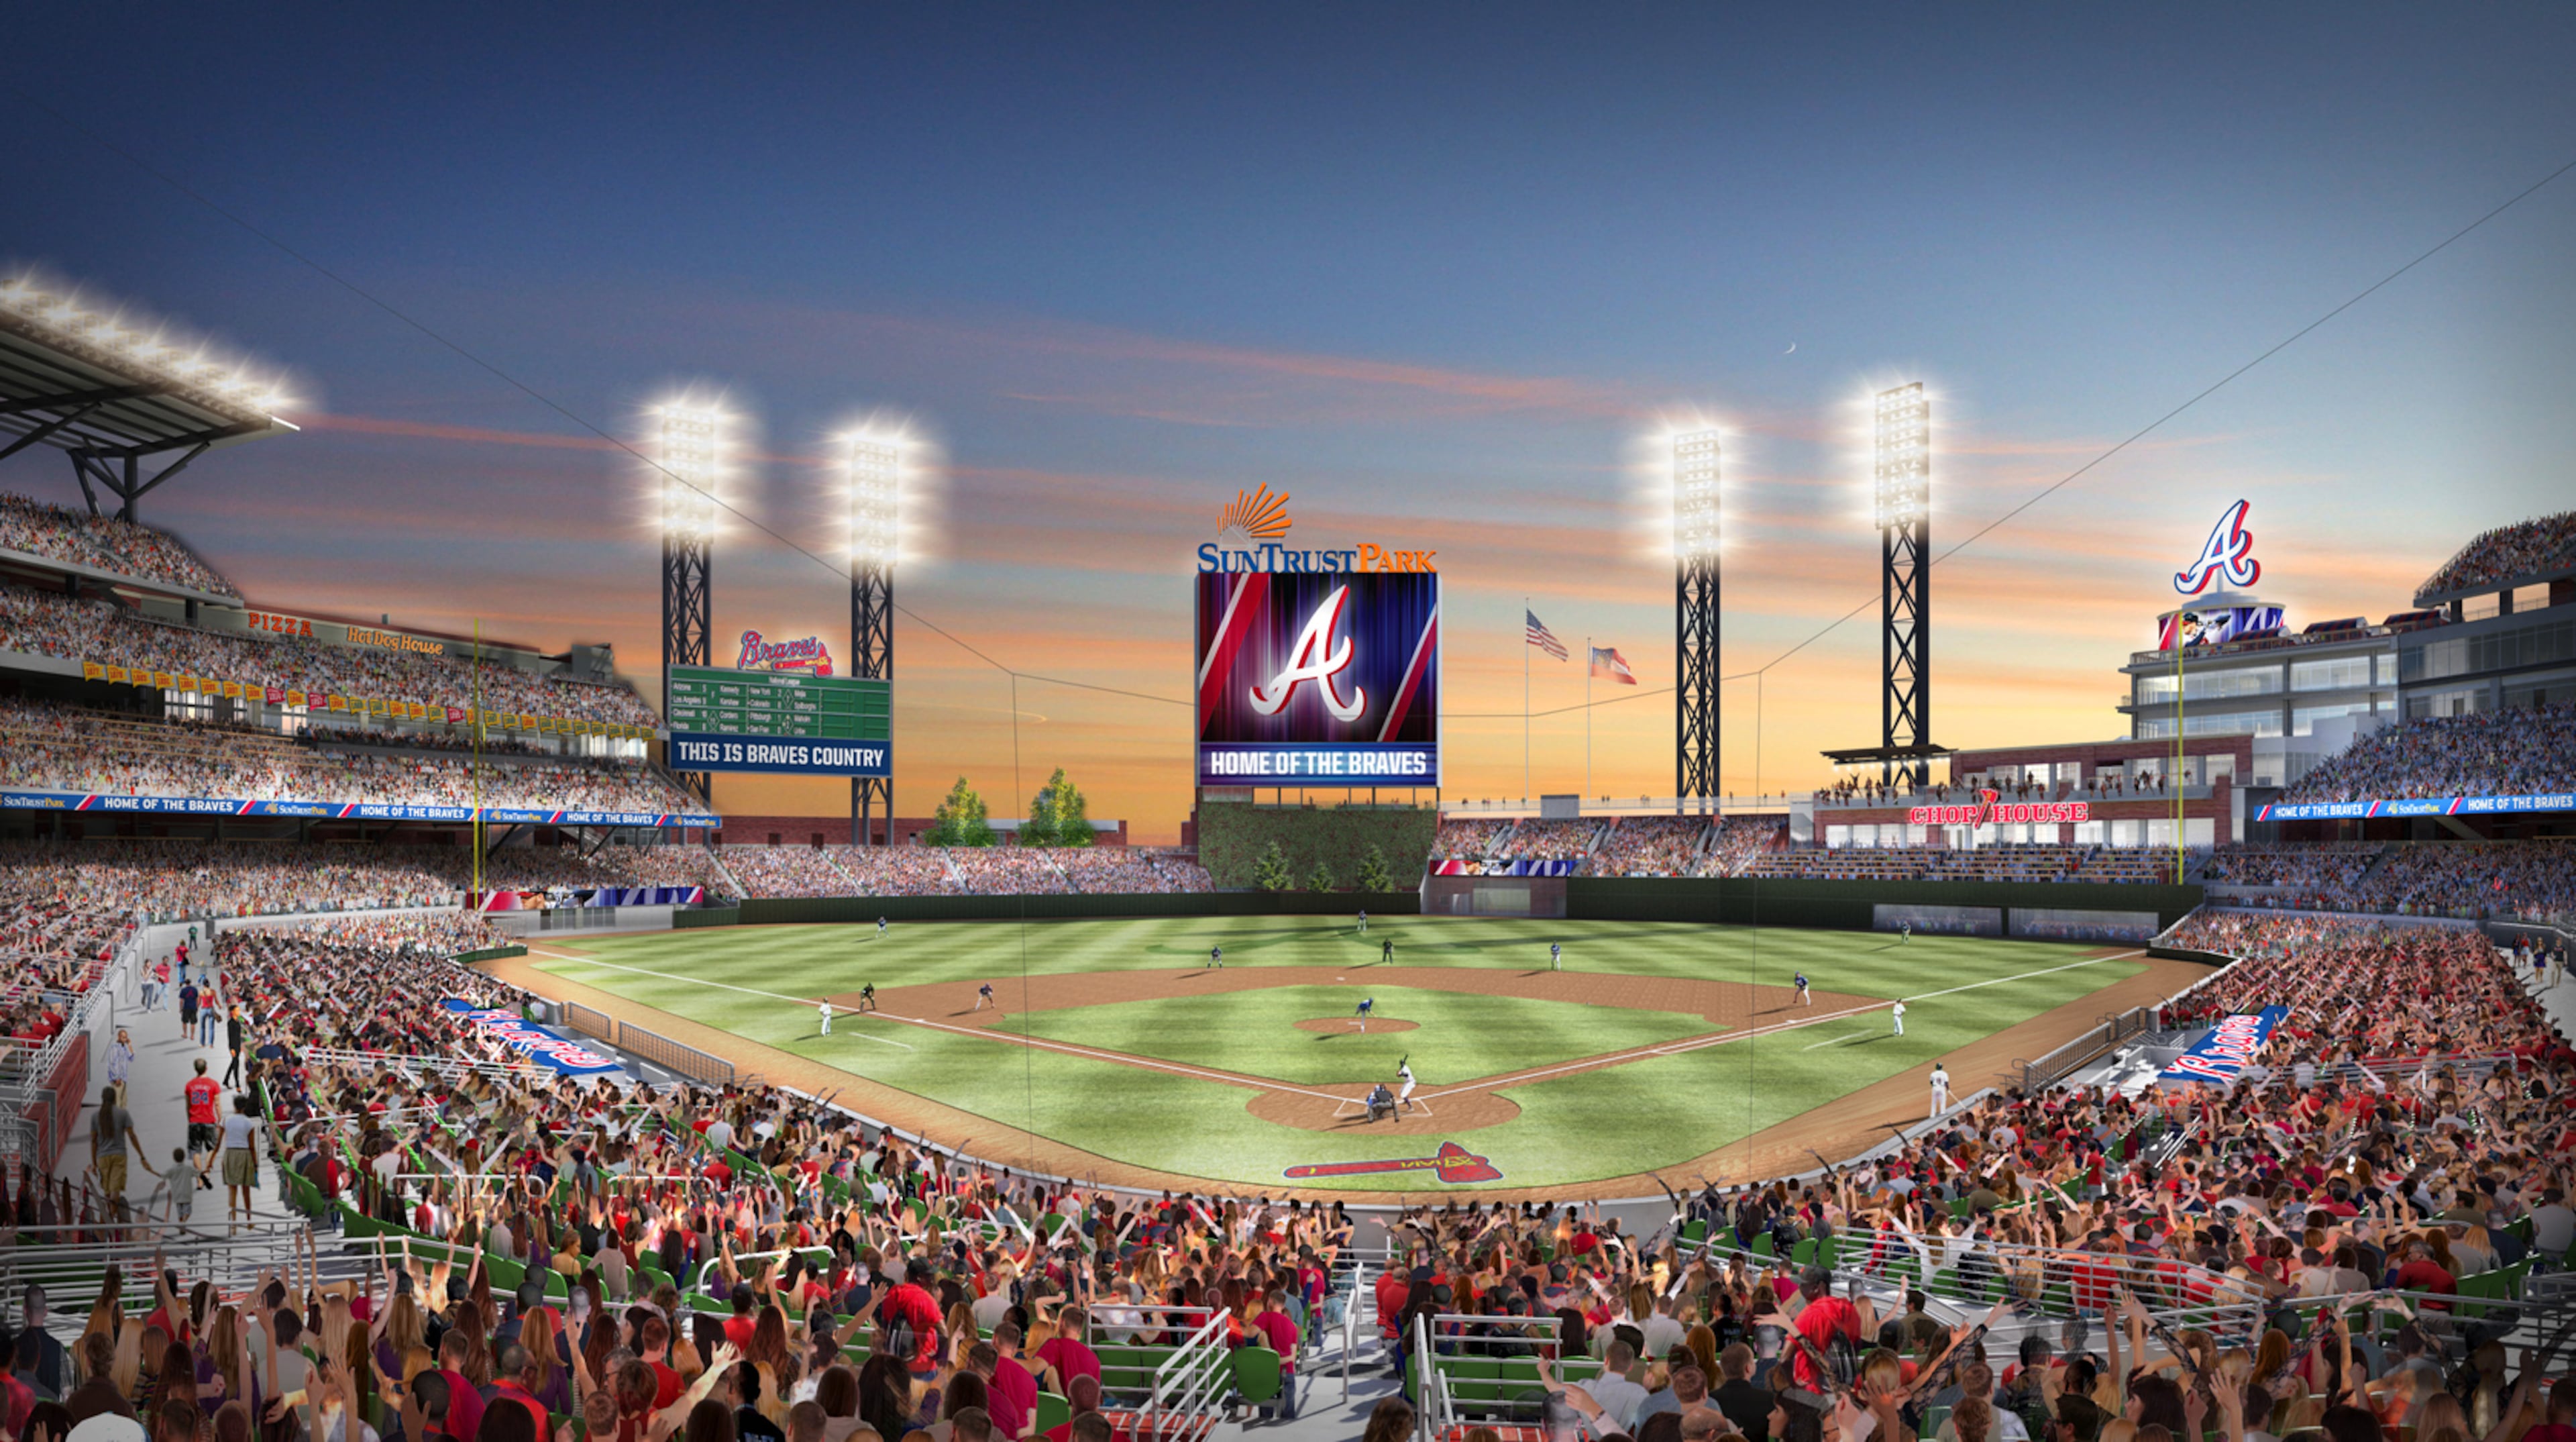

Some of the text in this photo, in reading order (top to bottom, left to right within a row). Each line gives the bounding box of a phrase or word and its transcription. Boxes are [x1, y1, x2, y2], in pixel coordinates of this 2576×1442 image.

[2174, 499, 2260, 595] A
[248, 612, 313, 637] PIZZA
[347, 627, 443, 656] Hot Dog House
[738, 630, 817, 670] Braves
[1249, 584, 1367, 722] A
[678, 741, 883, 767] THIS IS BRAVES COUNTRY
[1211, 752, 1427, 775] HOME OF THE BRAVES
[105, 797, 233, 812] HOME OF THE BRAVES
[361, 806, 464, 818] HOME OF THE BRAVES
[1911, 802, 2089, 825] CHOP HOUSE
[2275, 804, 2363, 817] HOME OF THE BRAVES
[2468, 795, 2574, 811] HOME OF THE BRAVES
[567, 813, 653, 824] HOME OF THE BRAVES
[192, 1091, 209, 1105] 24
